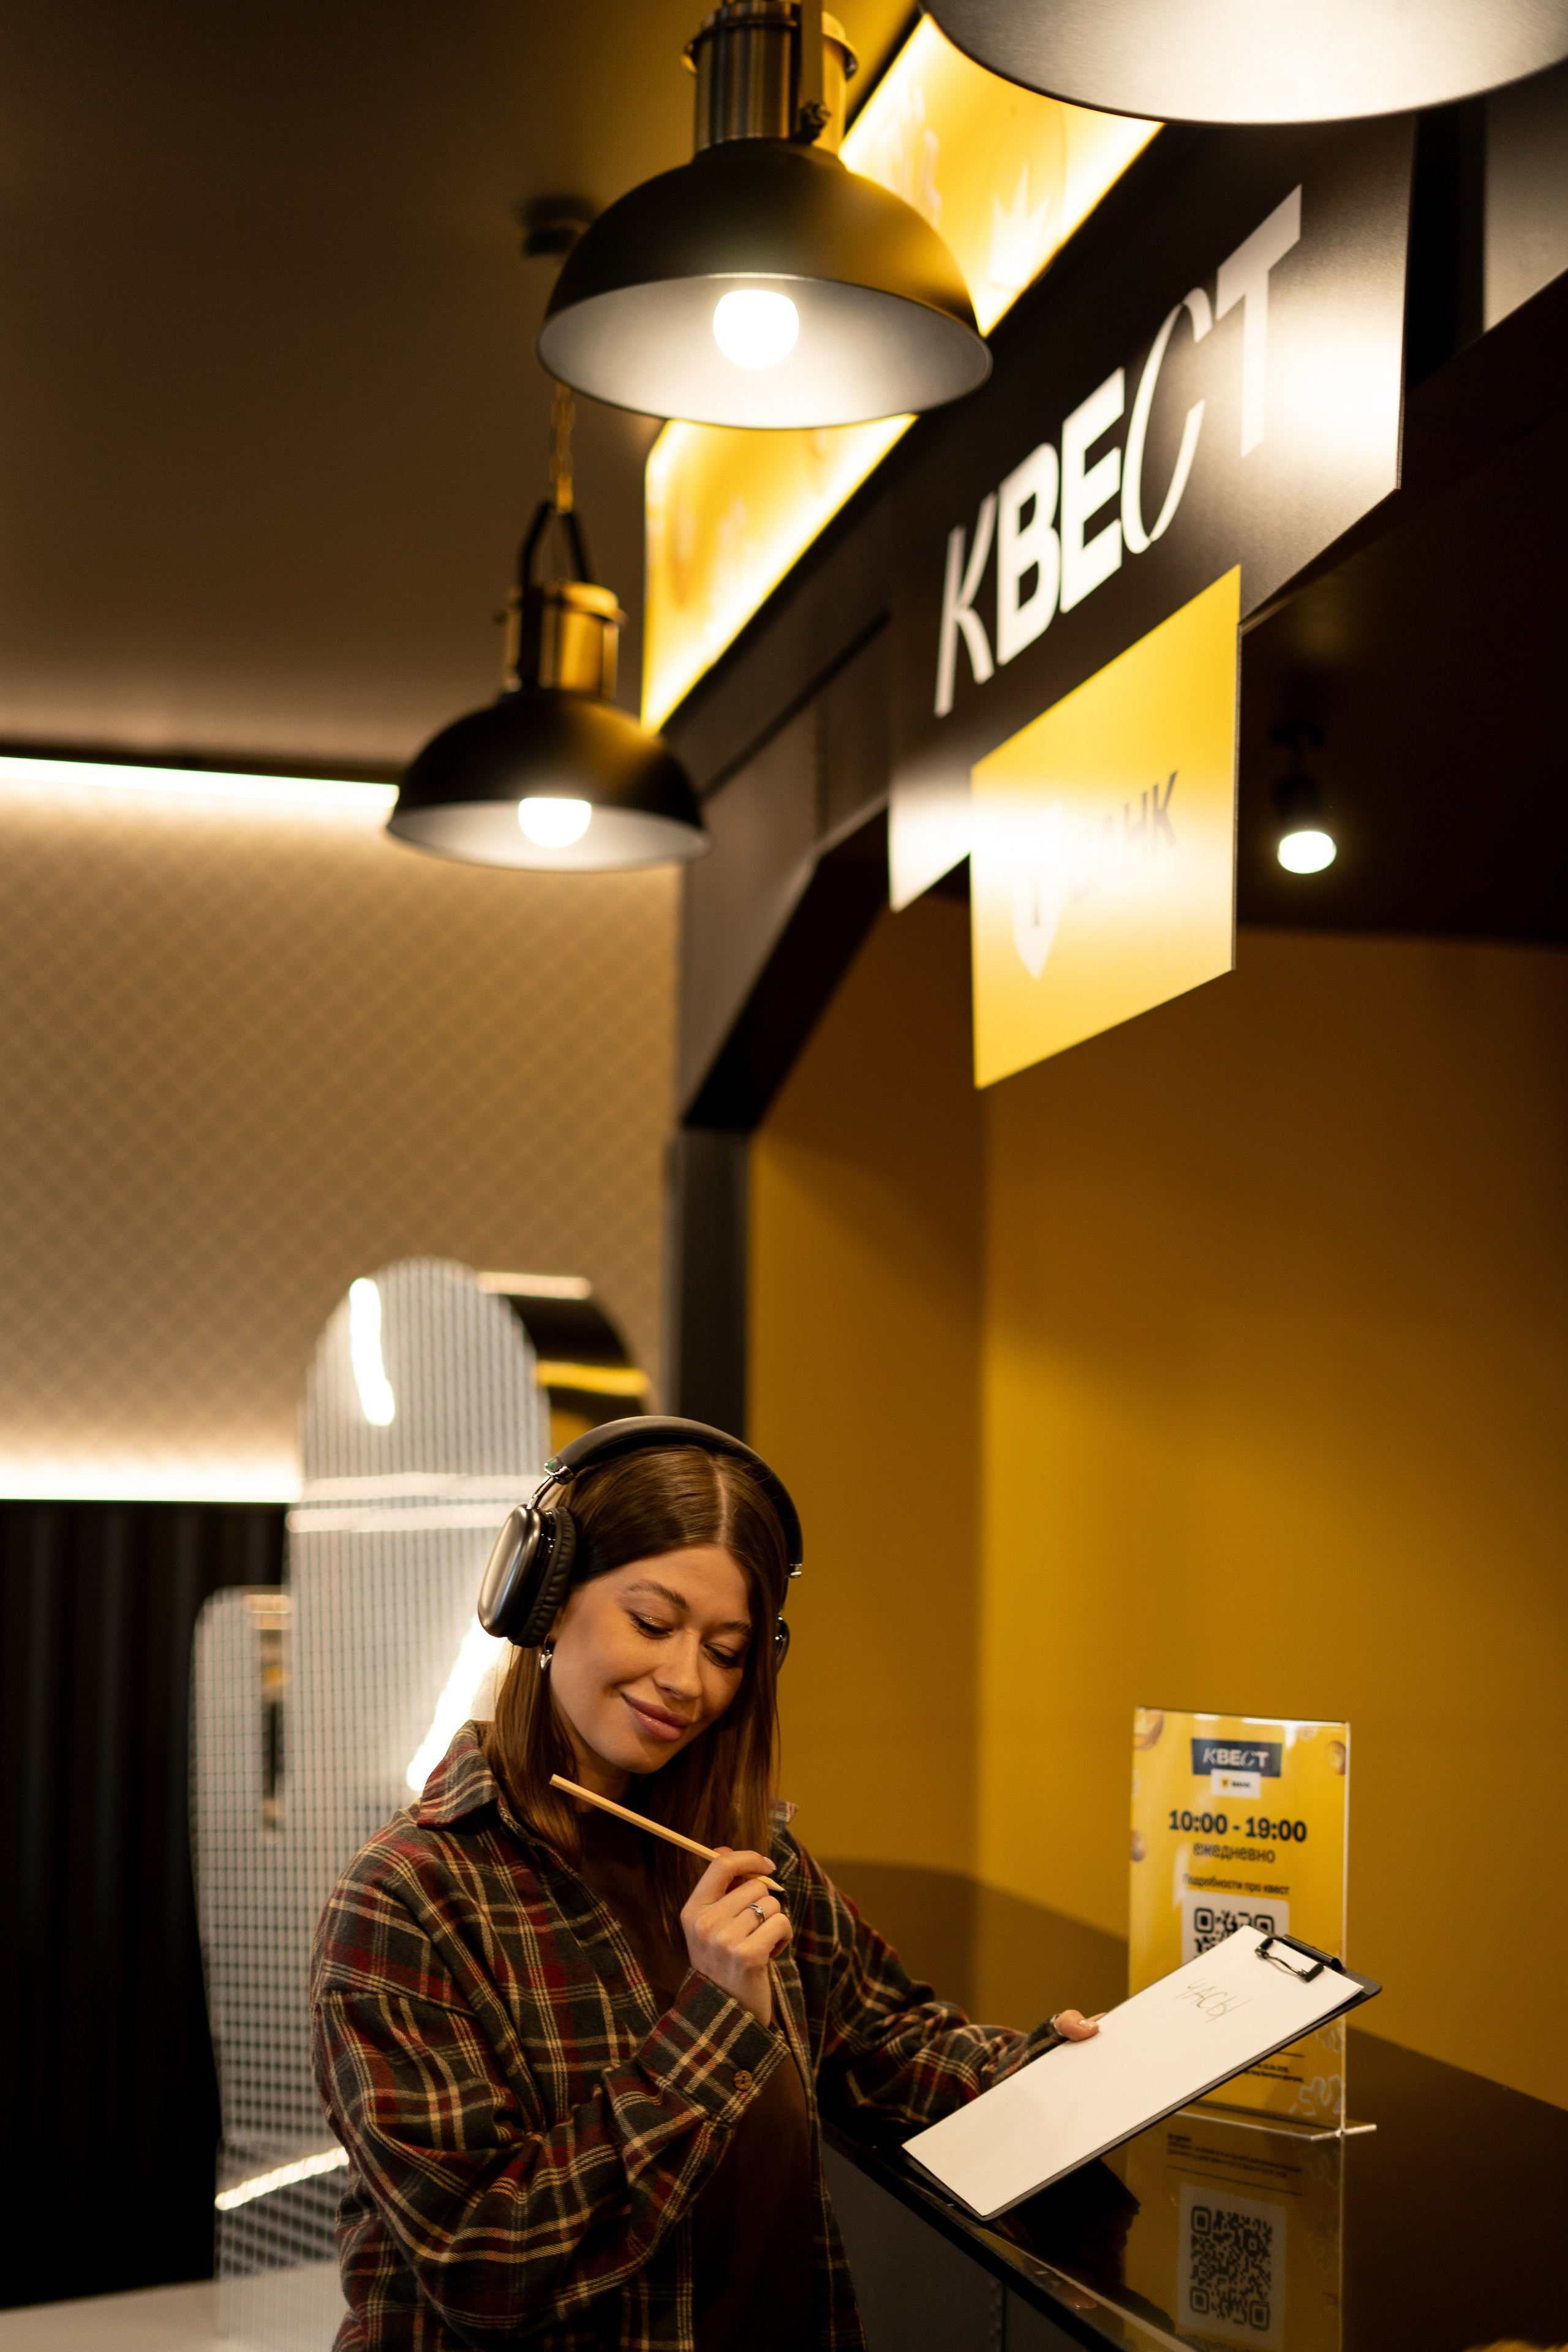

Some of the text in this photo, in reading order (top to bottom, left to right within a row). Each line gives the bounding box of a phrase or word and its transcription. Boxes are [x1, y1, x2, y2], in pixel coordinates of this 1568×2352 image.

[935, 184, 1302, 718] КВЕСТ
[1068, 769, 1178, 907] АНК
[1202, 1747, 1270, 1767] КВЕСТ
[1169, 1810, 1227, 1834] 10:00
[1245, 1817, 1306, 1842] 19:00
[1193, 1842, 1275, 1863] ежедневно
